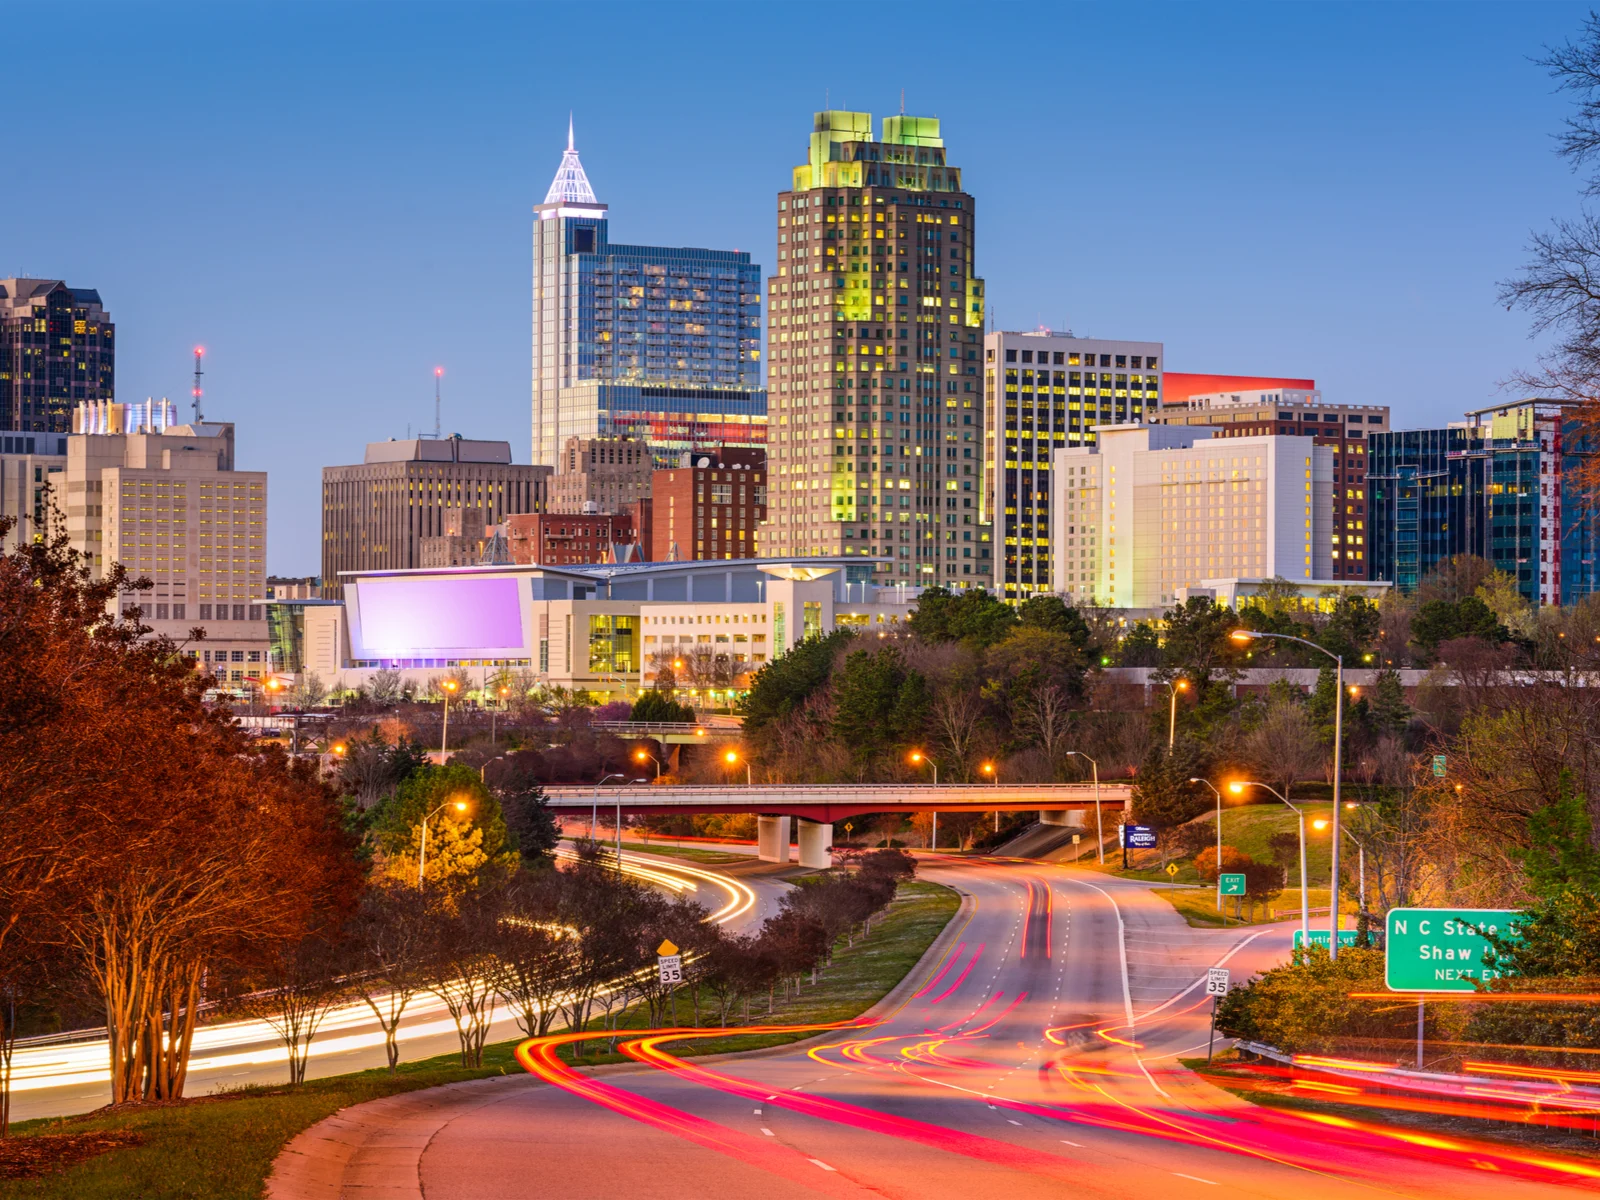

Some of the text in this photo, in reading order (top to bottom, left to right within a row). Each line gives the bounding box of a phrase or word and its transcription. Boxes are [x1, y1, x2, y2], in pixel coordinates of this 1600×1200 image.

[1130, 835, 1155, 843] RALEIGH
[1395, 920, 1407, 935] N
[1419, 920, 1431, 935] C
[1443, 921, 1497, 936] State
[1419, 945, 1471, 960] Shaw
[662, 970, 680, 981] 35
[1435, 969, 1514, 981] NEXT EXT
[1208, 981, 1226, 993] 35
